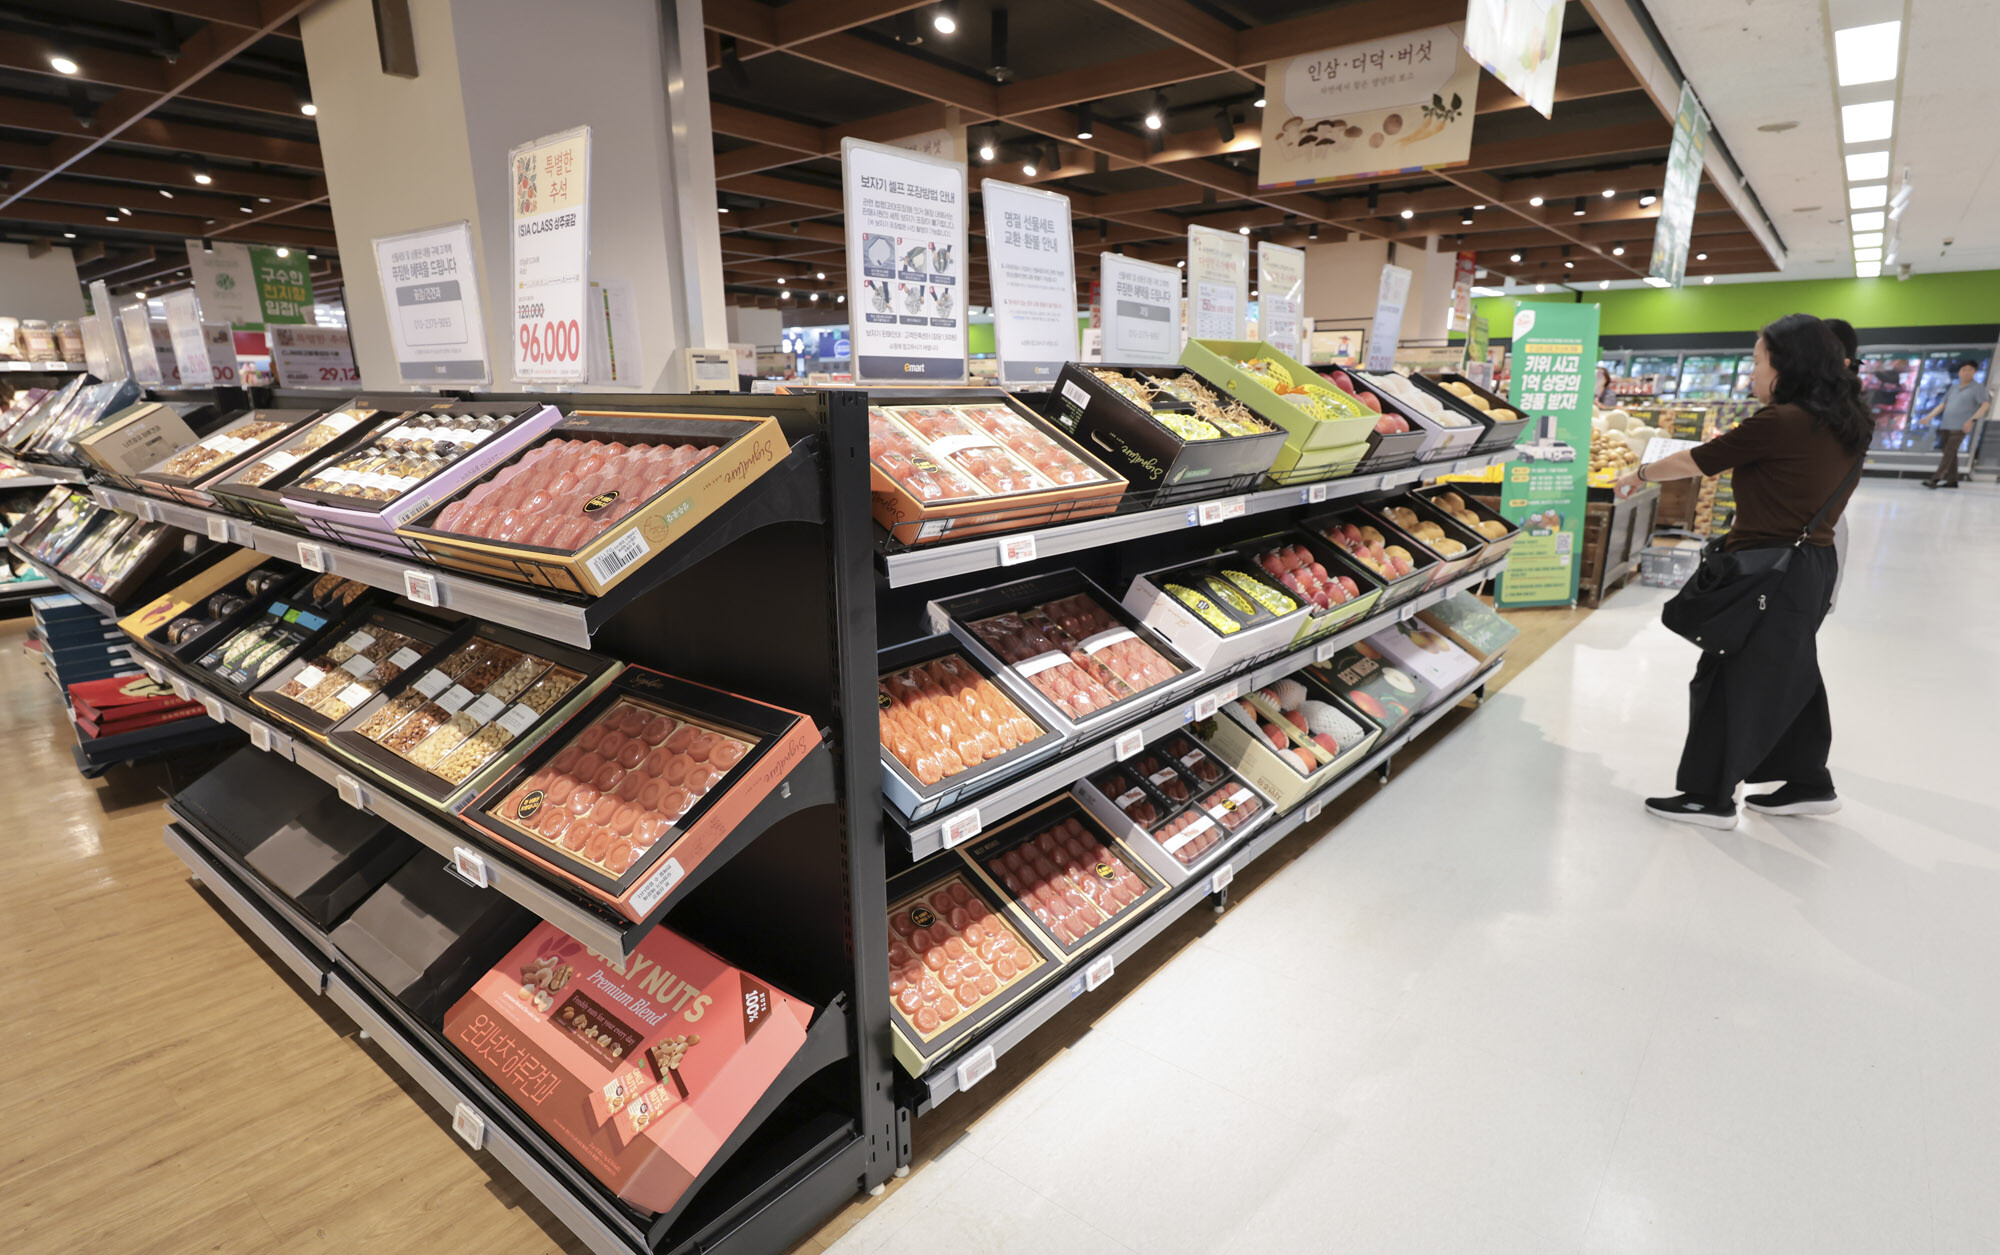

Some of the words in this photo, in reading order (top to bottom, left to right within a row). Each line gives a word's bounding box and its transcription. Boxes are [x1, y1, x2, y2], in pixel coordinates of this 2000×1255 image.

[1308, 40, 1432, 82] 인삼·더덕·버섯
[545, 148, 573, 176] 특별한
[550, 178, 567, 203] 추석
[860, 176, 887, 192] 보자기
[889, 181, 905, 194] 셀프
[906, 184, 938, 201] 포장방법
[939, 190, 955, 204] 안내
[532, 218, 554, 234] CLASS
[554, 212, 576, 230] 상주곶감
[1004, 211, 1022, 229] 명절
[1024, 216, 1055, 233] 선물세트
[1042, 236, 1058, 253] 안내
[392, 265, 410, 282] 푸짐한
[410, 262, 429, 279] 혜택을
[430, 258, 457, 276] 드립니다
[518, 303, 544, 319] 120,000
[520, 320, 580, 365] 96,000
[318, 368, 359, 382] 29,12
[904, 363, 924, 372] emart
[1524, 355, 1552, 372] 키위
[1552, 356, 1580, 372] 사고
[1522, 374, 1541, 391] 1억
[1542, 374, 1582, 392] 상당의
[1520, 393, 1546, 410] 경품
[1547, 393, 1578, 410] 받자!
[724, 440, 773, 483] Signature
[1121, 445, 1163, 480] Signature
[763, 736, 806, 783] Signature
[587, 969, 633, 1007] Premium
[629, 998, 667, 1026] Blend
[638, 965, 712, 1022] NUTS
[745, 990, 760, 1023] 100%
[570, 994, 590, 1011] Freshly
[586, 1006, 598, 1017] nuts
[596, 1012, 605, 1022] for
[602, 1019, 615, 1030] your
[612, 1026, 627, 1039] every
[623, 1034, 636, 1046] day
[460, 1014, 515, 1067] 온리넛츠
[502, 1048, 561, 1106] 하루견과
[625, 1072, 638, 1093] NUTS
[632, 1067, 644, 1085] ONLY
[649, 1089, 662, 1110] NUTS
[657, 1084, 670, 1102] ONLY
